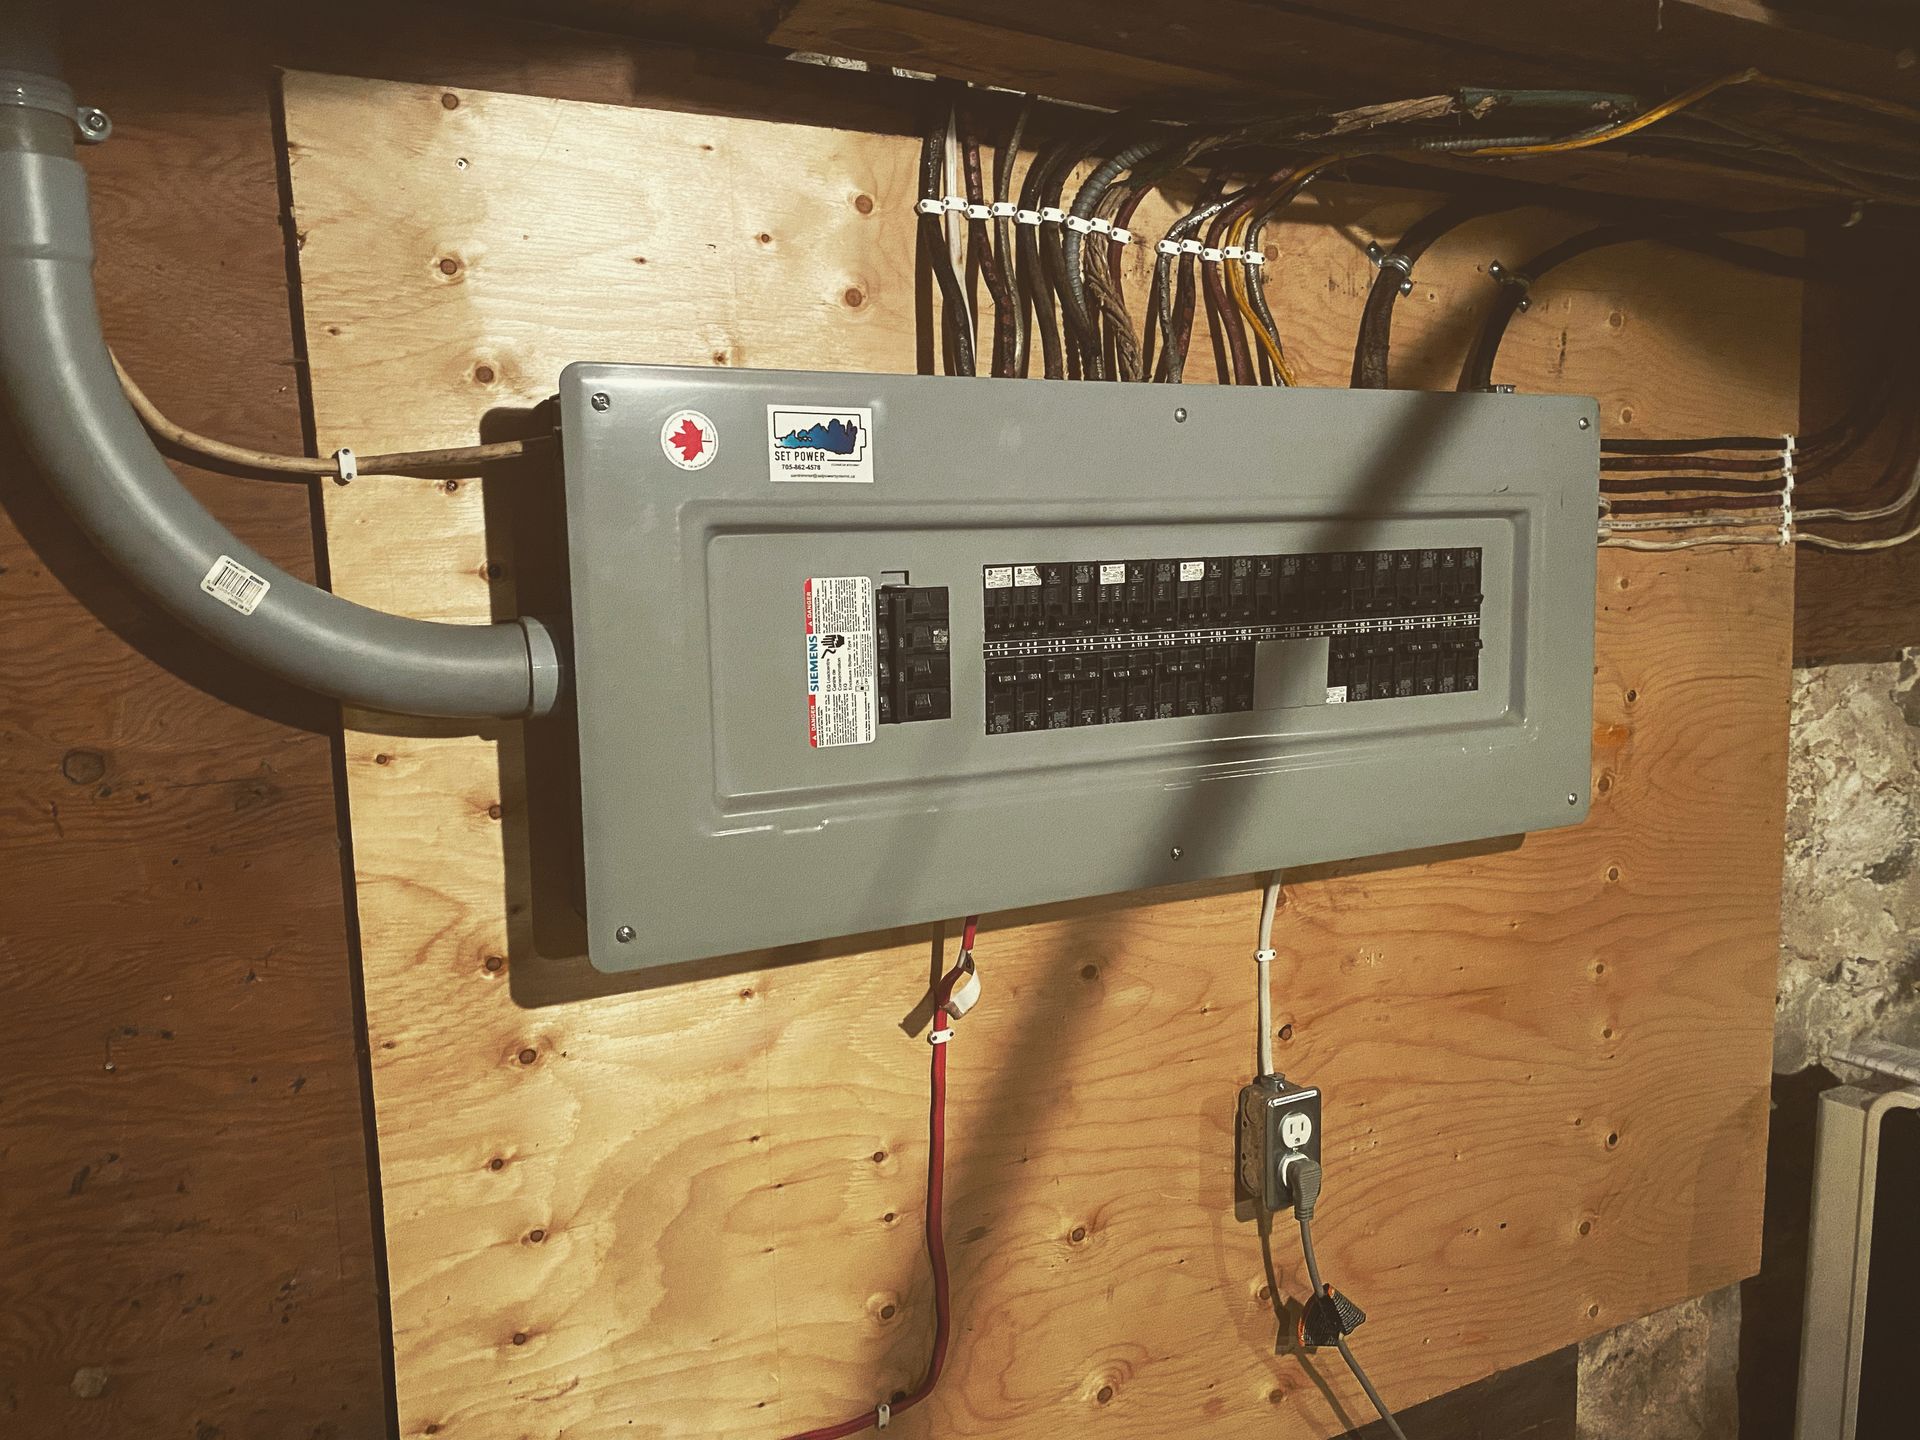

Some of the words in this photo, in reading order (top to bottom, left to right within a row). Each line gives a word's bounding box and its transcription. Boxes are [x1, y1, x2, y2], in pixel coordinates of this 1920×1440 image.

[774, 450, 791, 461] SET
[795, 452, 825, 462] POWER
[808, 635, 819, 692] SIEMENS
